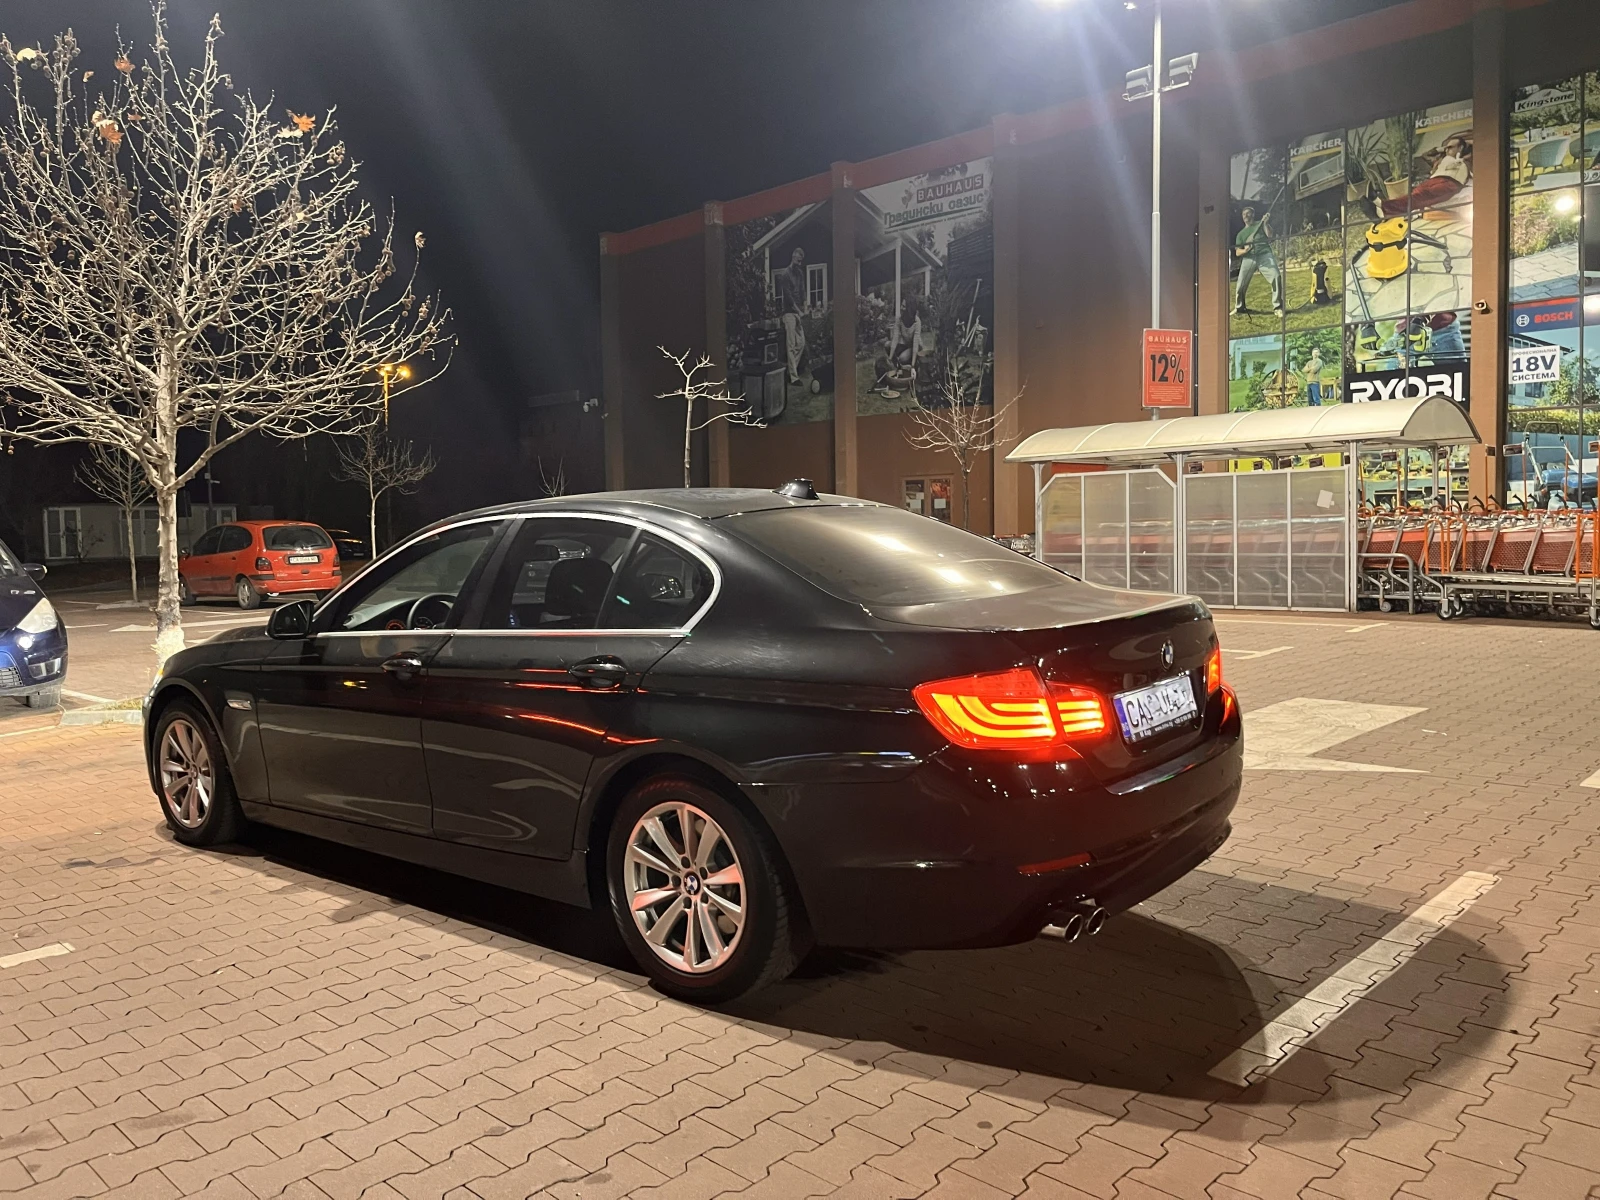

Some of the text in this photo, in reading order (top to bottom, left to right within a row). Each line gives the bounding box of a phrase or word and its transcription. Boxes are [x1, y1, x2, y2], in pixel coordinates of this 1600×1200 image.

[1517, 93, 1574, 110] Kingstone
[917, 175, 983, 202] BAUHAUS
[883, 201, 944, 227] Градински
[948, 193, 984, 210] оазис
[1534, 311, 1574, 324] BOSCH
[1148, 335, 1187, 344] BAUHAUS
[1512, 348, 1557, 356] ПРОФЕСИОНАЛНА
[1150, 353, 1185, 383] 12%
[1512, 354, 1557, 373] 18V
[1512, 372, 1556, 382] СИСТЕМА
[1349, 372, 1463, 404] RYOBI
